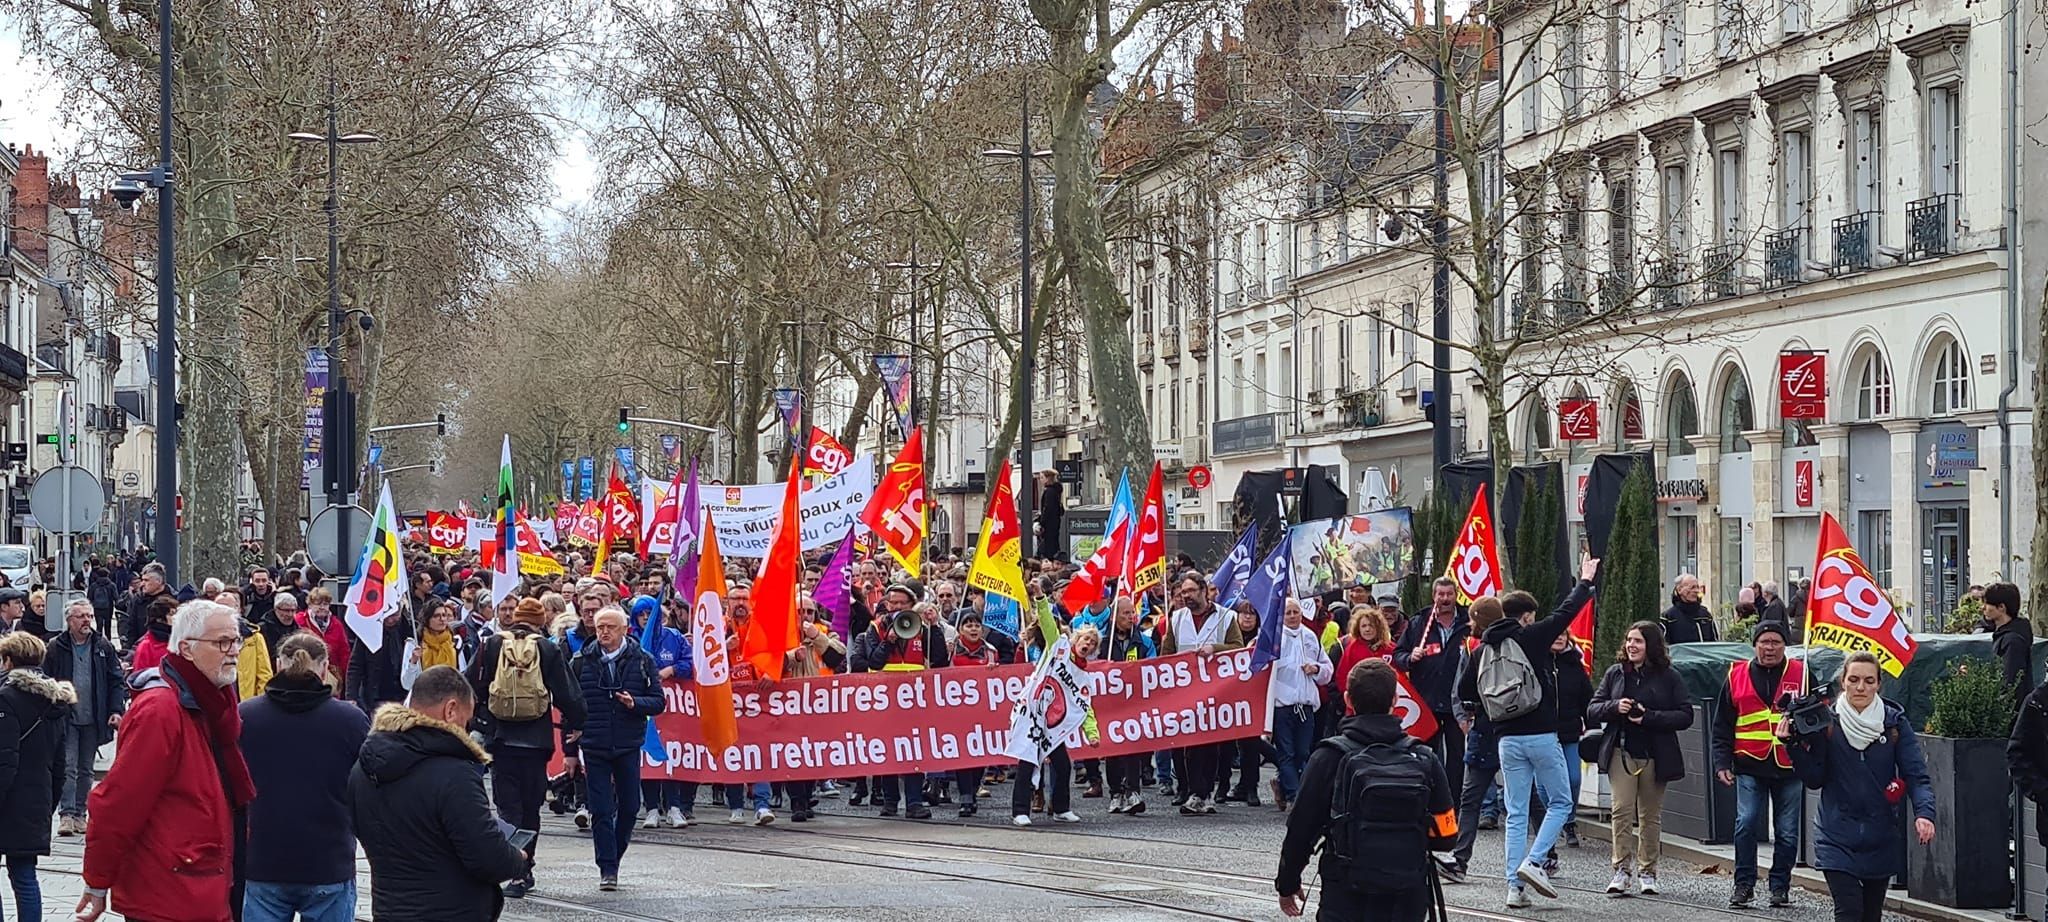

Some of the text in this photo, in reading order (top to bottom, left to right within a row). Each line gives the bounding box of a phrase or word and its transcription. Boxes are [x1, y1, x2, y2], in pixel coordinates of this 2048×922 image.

[431, 526, 466, 548] cgt
[975, 571, 1013, 595] SECTEUR DE
[768, 679, 890, 716] salaires
[896, 674, 927, 711] et
[933, 673, 980, 707] les
[1141, 665, 1192, 699] pas
[724, 743, 762, 773] en
[770, 731, 886, 769] retraite
[895, 727, 923, 762] ni
[928, 726, 963, 761] la
[1107, 699, 1252, 744] cotisation
